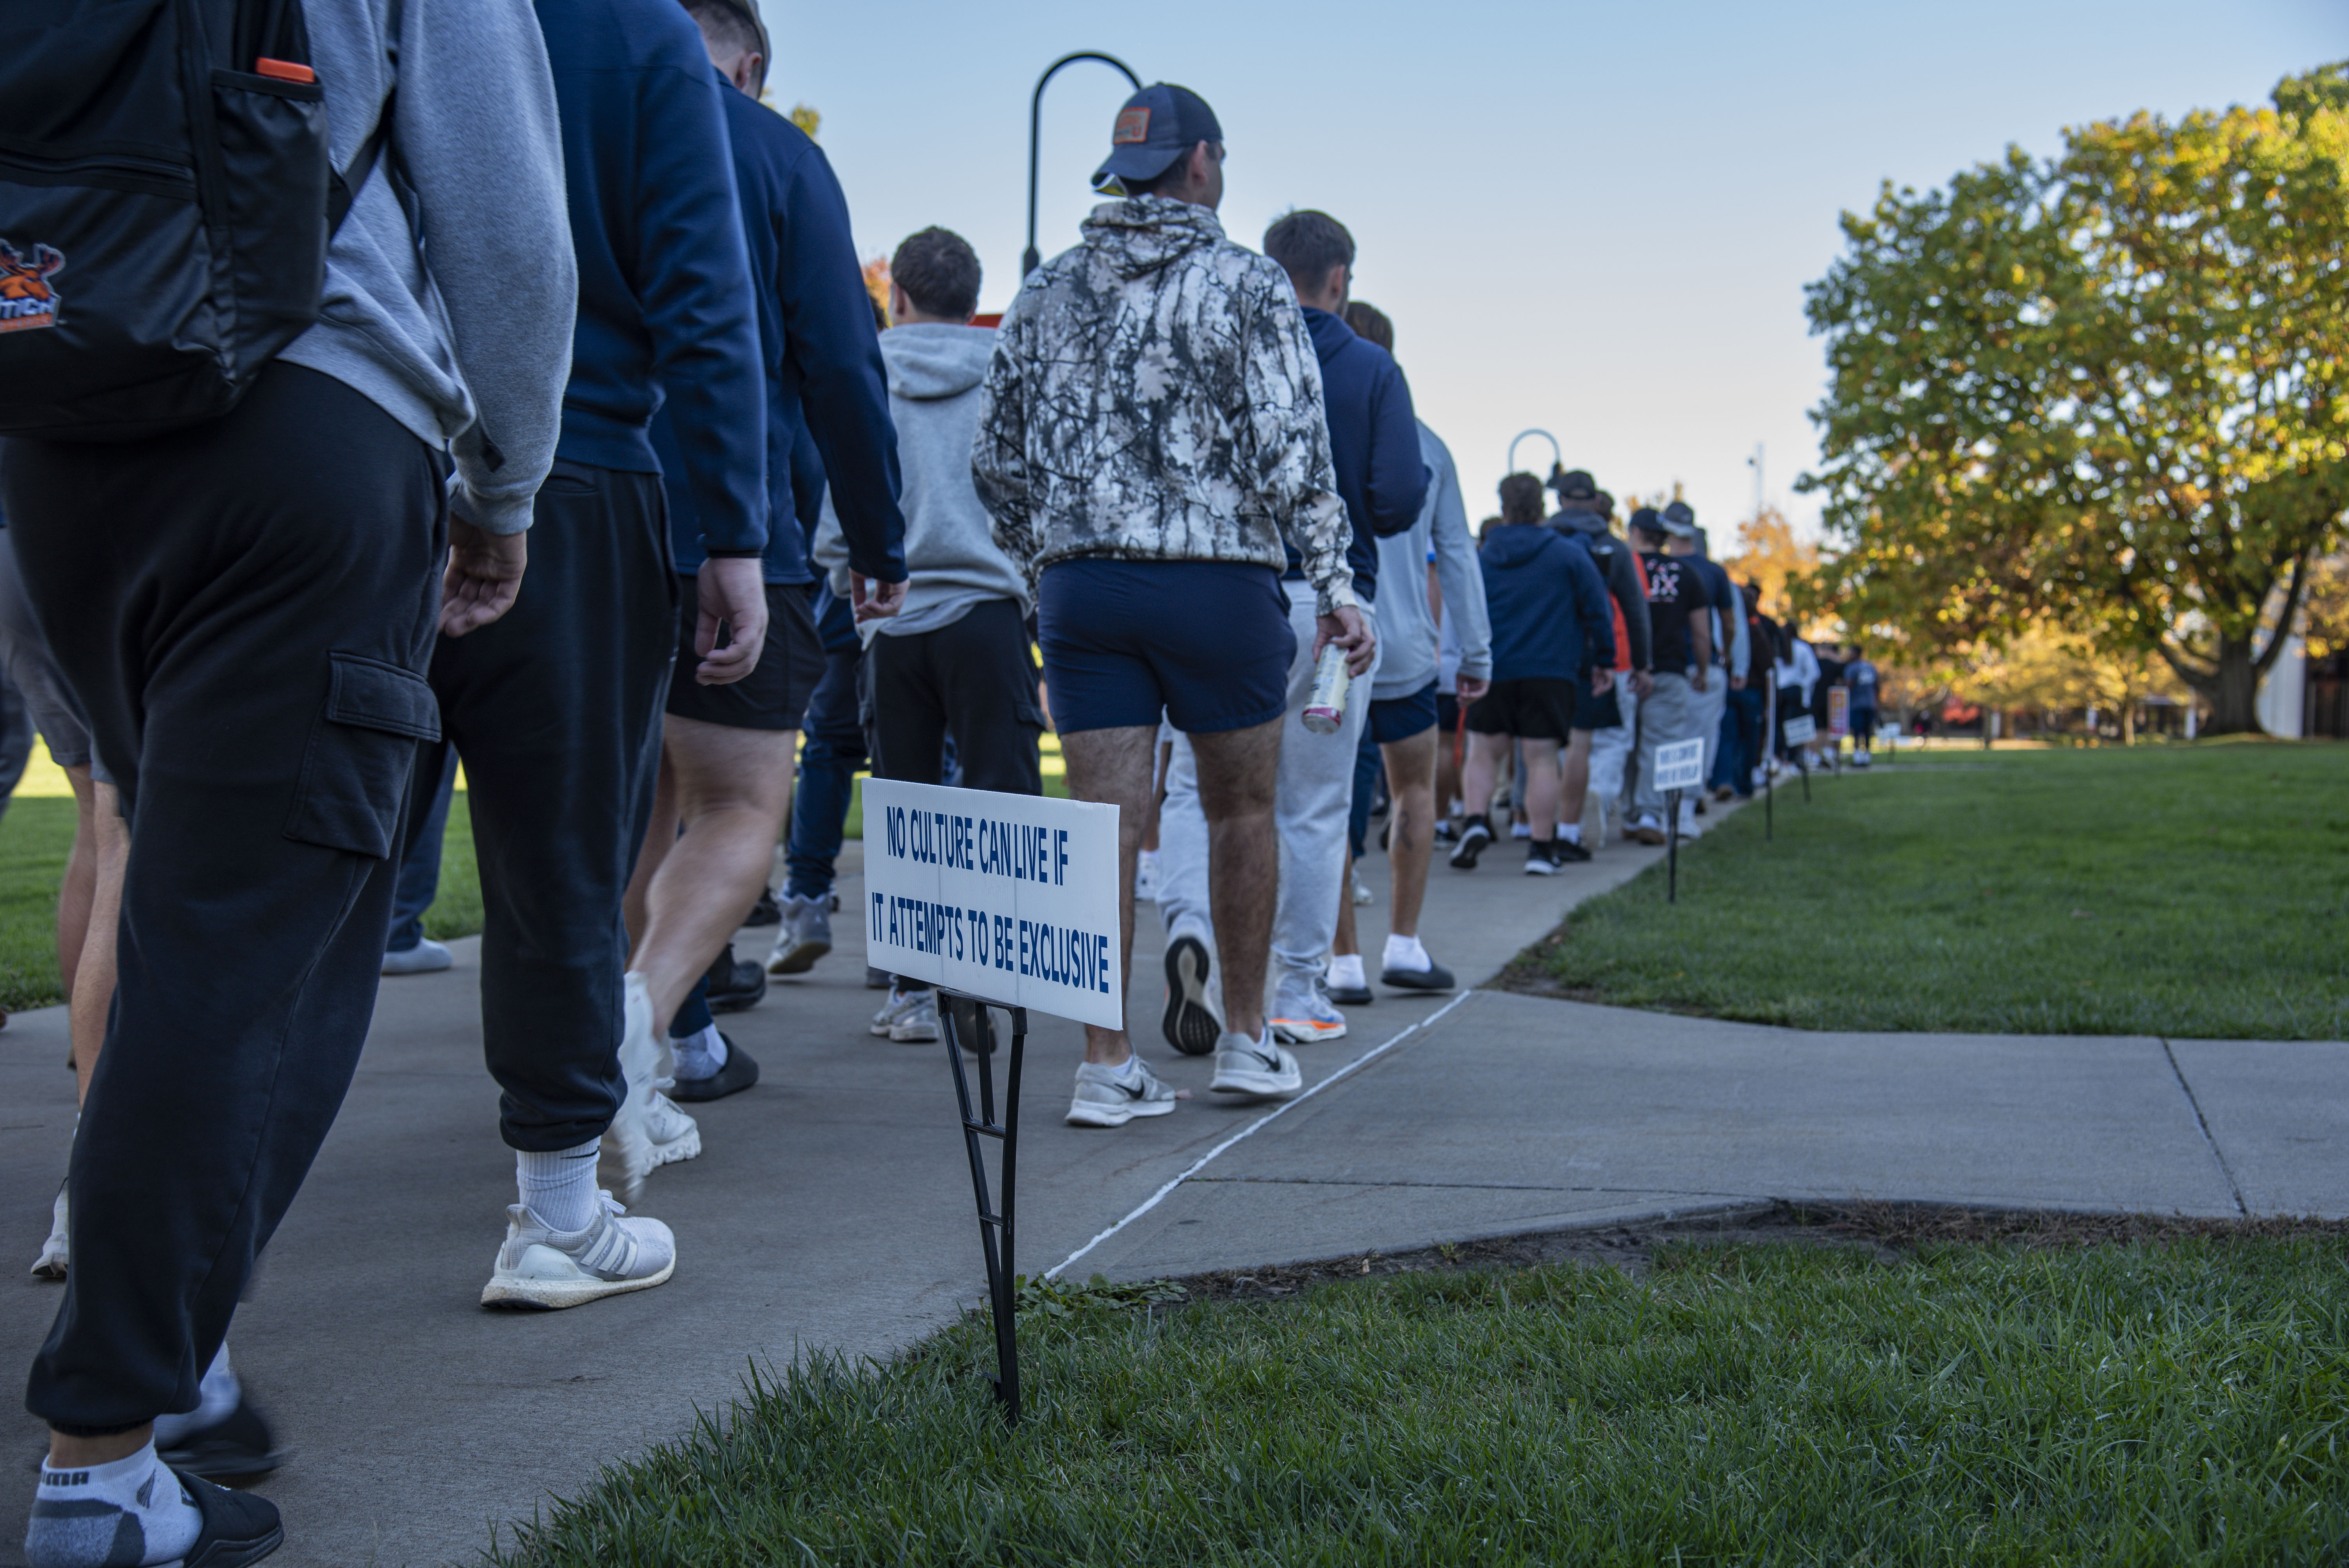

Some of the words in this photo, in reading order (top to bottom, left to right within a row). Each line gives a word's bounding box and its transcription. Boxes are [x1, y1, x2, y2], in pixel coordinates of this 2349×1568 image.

[886, 806, 905, 859] NO
[911, 809, 974, 870] CULTURE
[979, 818, 1011, 877] CAN
[1015, 824, 1048, 883] LIVE
[1054, 829, 1068, 886] IF
[872, 892, 883, 942] IT
[890, 895, 964, 961] ATTEMPTS
[968, 909, 988, 966] TO
[994, 915, 1014, 972] BE
[1019, 920, 1109, 994] EXCLUSIVE
